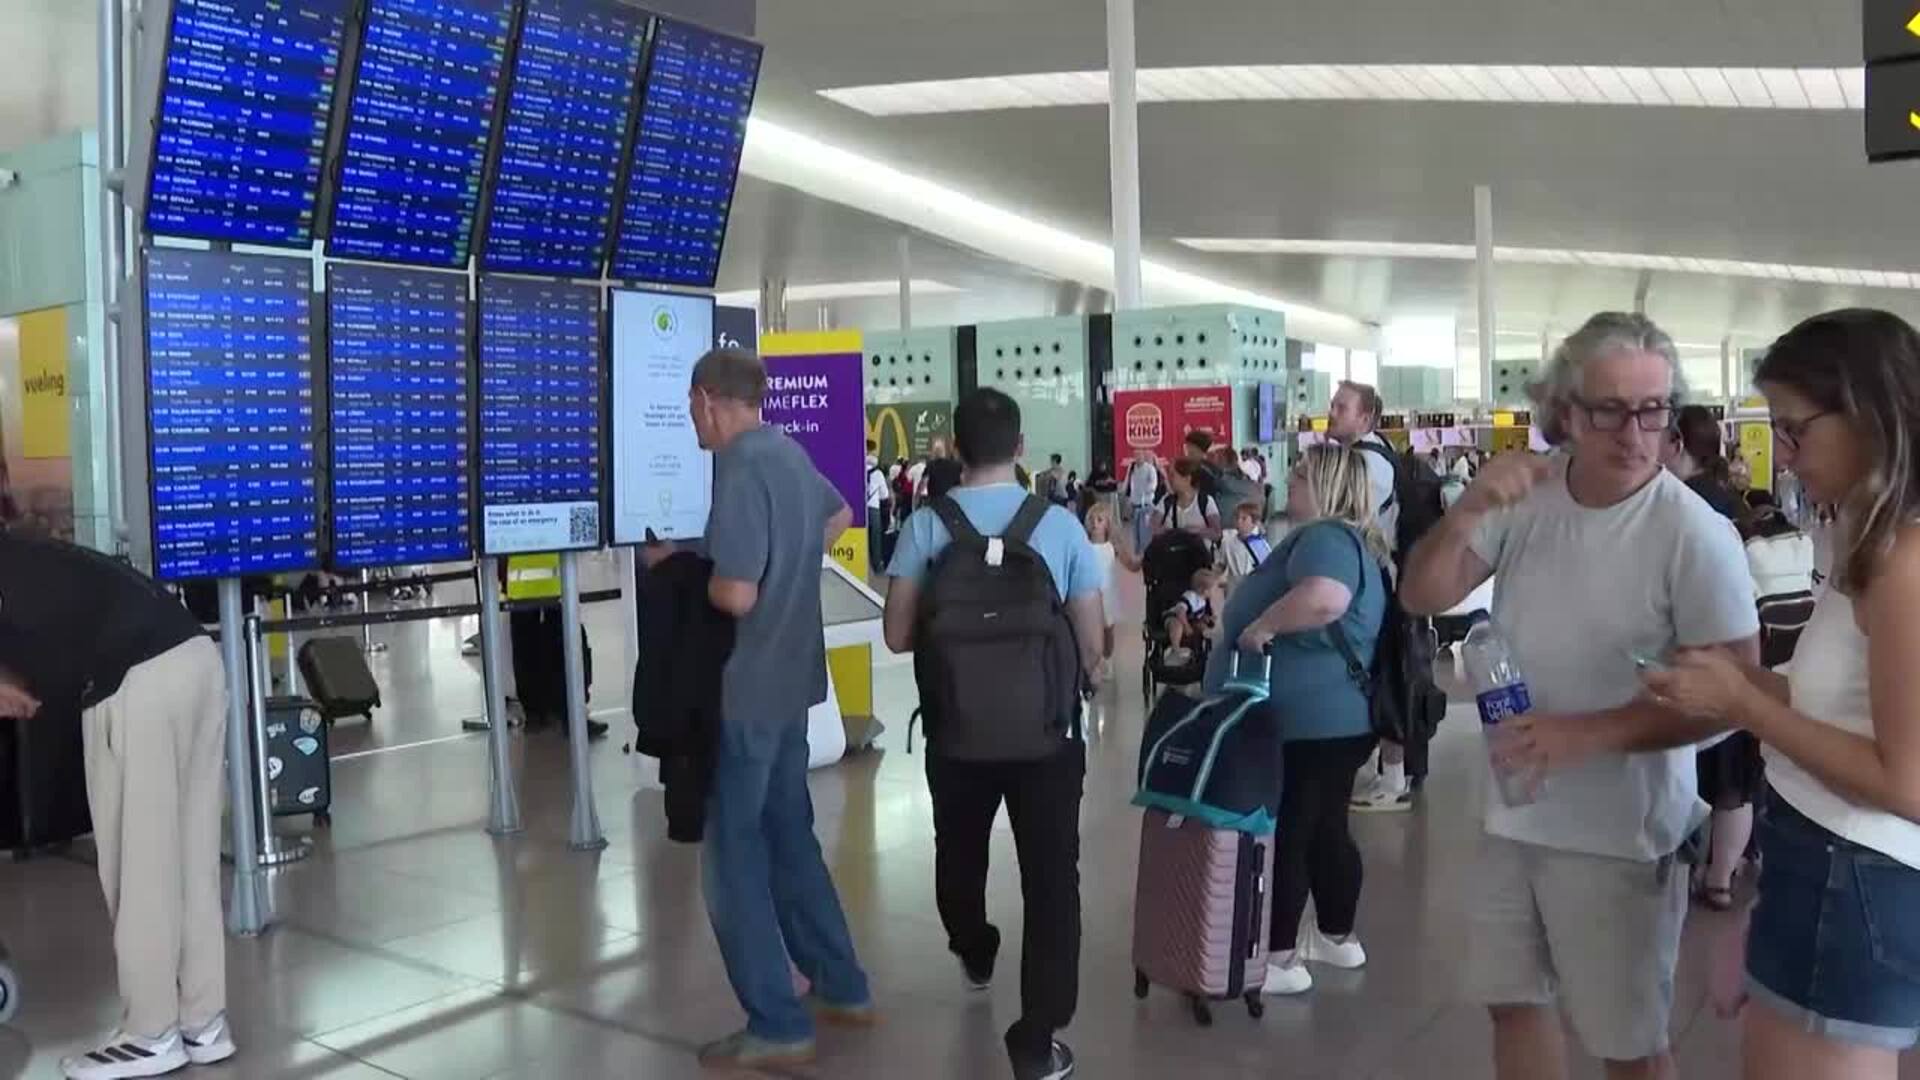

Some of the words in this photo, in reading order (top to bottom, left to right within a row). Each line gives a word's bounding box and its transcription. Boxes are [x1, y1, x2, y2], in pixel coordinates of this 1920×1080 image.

[766, 374, 828, 390] REMIUM
[763, 394, 828, 409] IMEFLEX
[1128, 424, 1160, 438] KING
[528, 517, 558, 525] emergency
